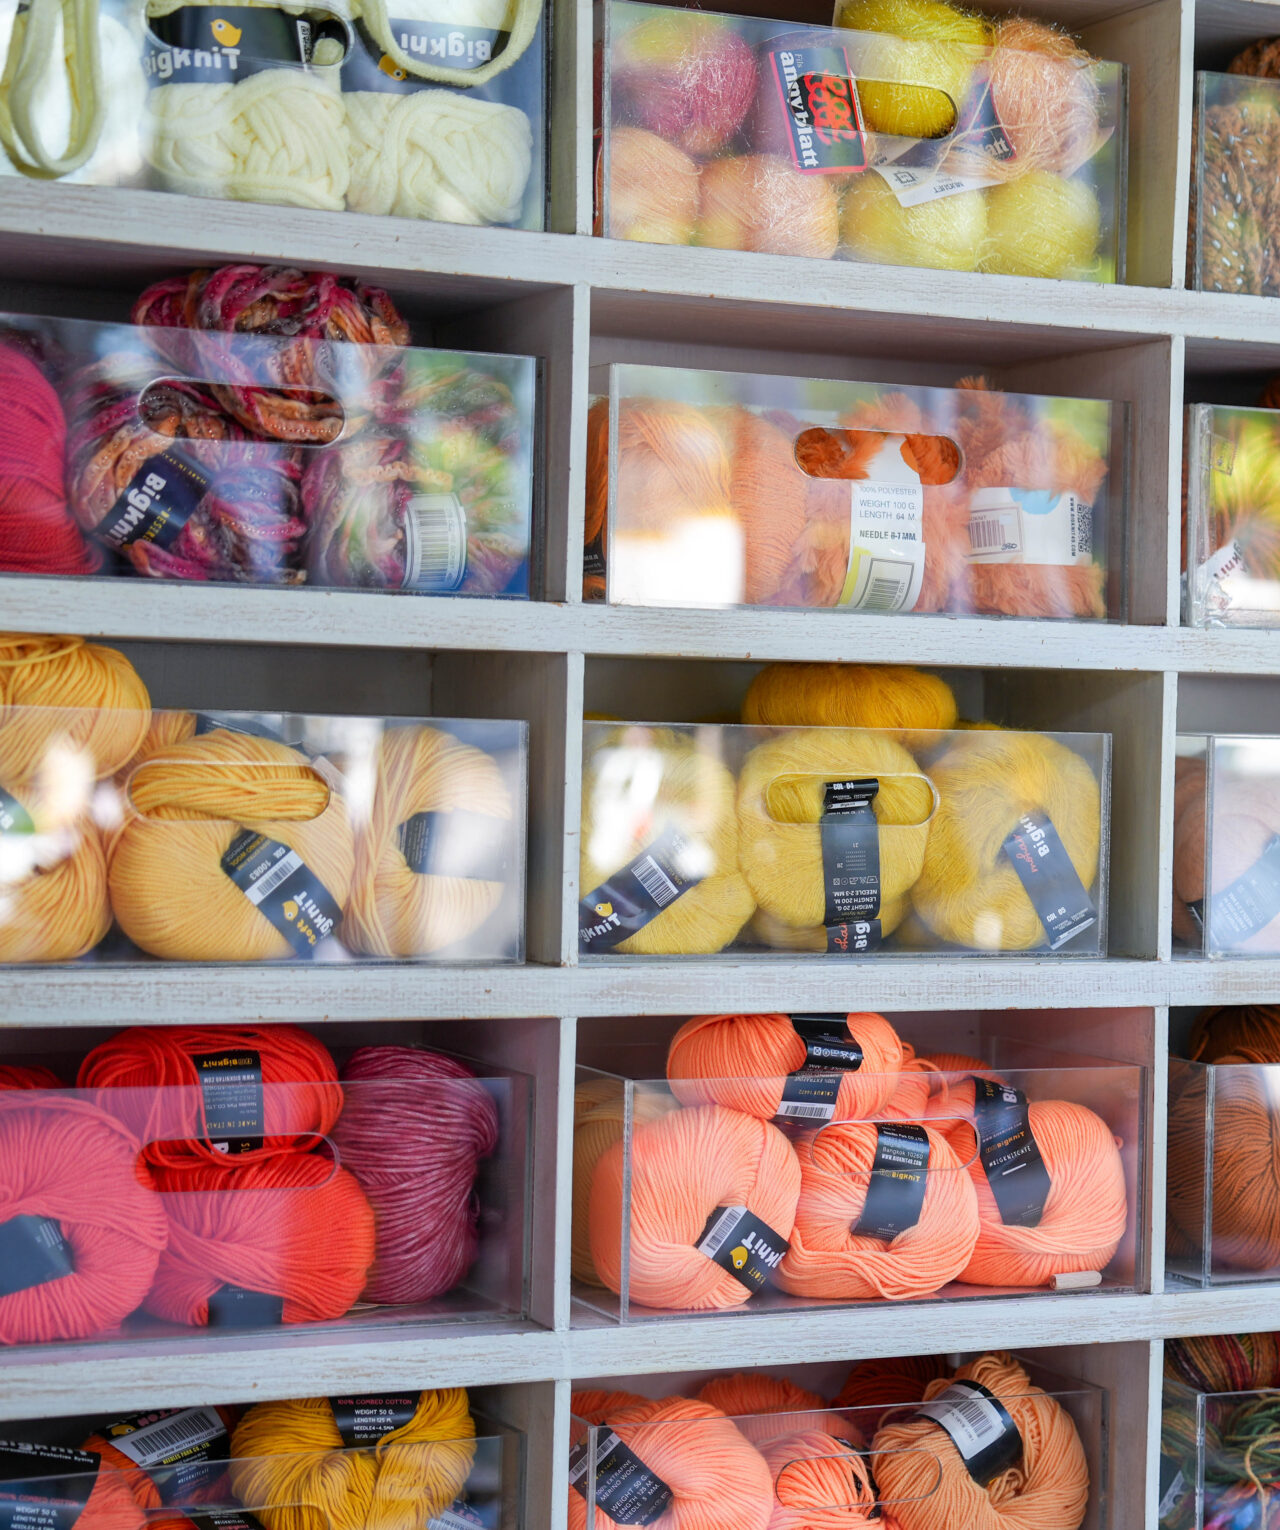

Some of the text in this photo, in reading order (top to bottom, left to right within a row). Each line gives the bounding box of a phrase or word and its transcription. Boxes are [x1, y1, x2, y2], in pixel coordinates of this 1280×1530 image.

[878, 487, 917, 496] POLYESTER
[859, 499, 890, 509] WEIGHT
[893, 502, 906, 510] 100
[859, 510, 892, 520] LENGTH
[895, 512, 905, 520] 64
[859, 530, 889, 540] NEEDLE
[355, 1398, 383, 1406] COMBED
[385, 1398, 412, 1406] COTTON
[606, 1459, 633, 1486] EXTRAFINE
[600, 1464, 638, 1502] MERINO WOOL
[610, 1487, 635, 1512] WEIGHT
[633, 1480, 642, 1489] 50
[16, 1505, 40, 1514] WEIGHT
[616, 1495, 638, 1518] LENGTH
[621, 1502, 642, 1522] NEEDLE
